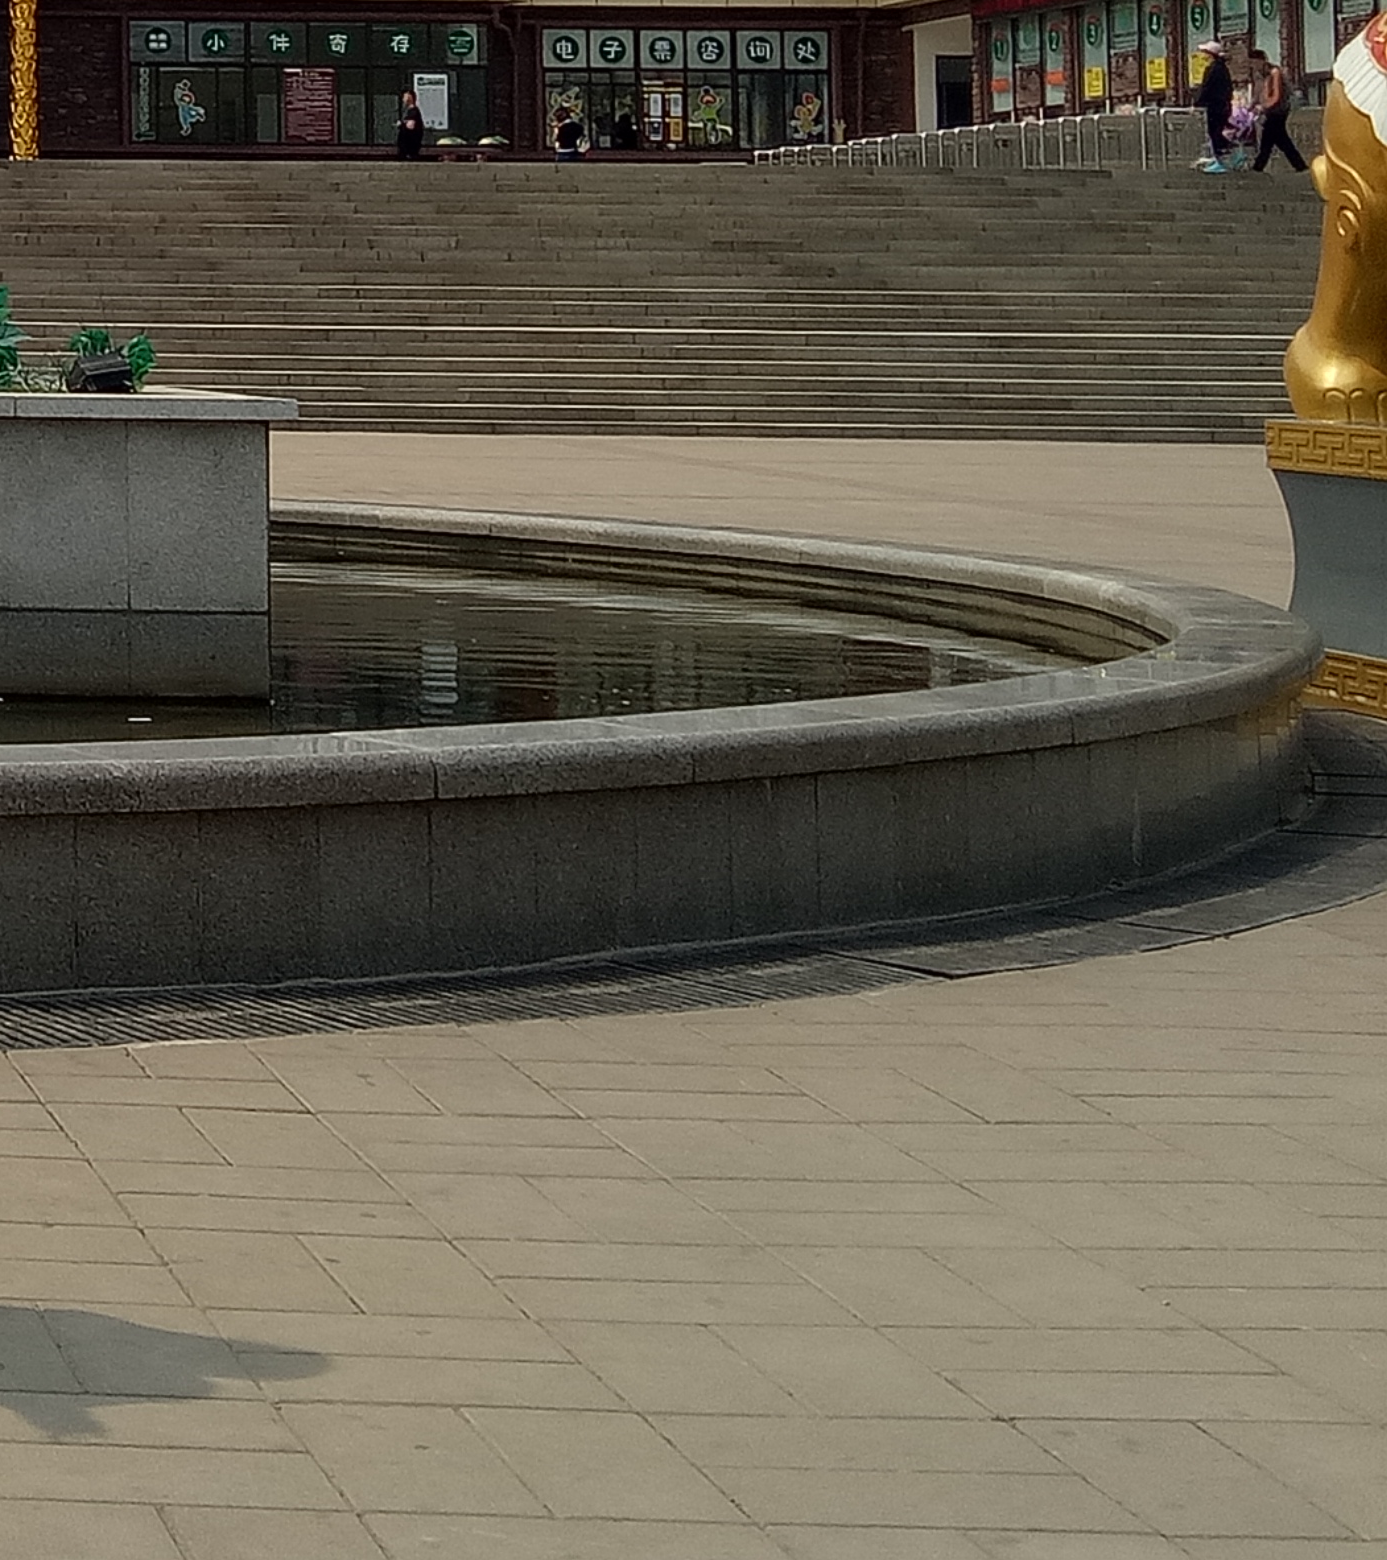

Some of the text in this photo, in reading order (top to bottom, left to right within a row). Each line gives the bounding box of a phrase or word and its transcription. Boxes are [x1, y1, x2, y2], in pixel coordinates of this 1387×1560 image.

[1151, 14, 1160, 32] 4
[1194, 9, 1202, 27] 5
[1051, 32, 1059, 51] 2
[1088, 24, 1096, 43] 3
[206, 33, 411, 54] 小件寄存
[555, 39, 817, 61] 电子票咨询处
